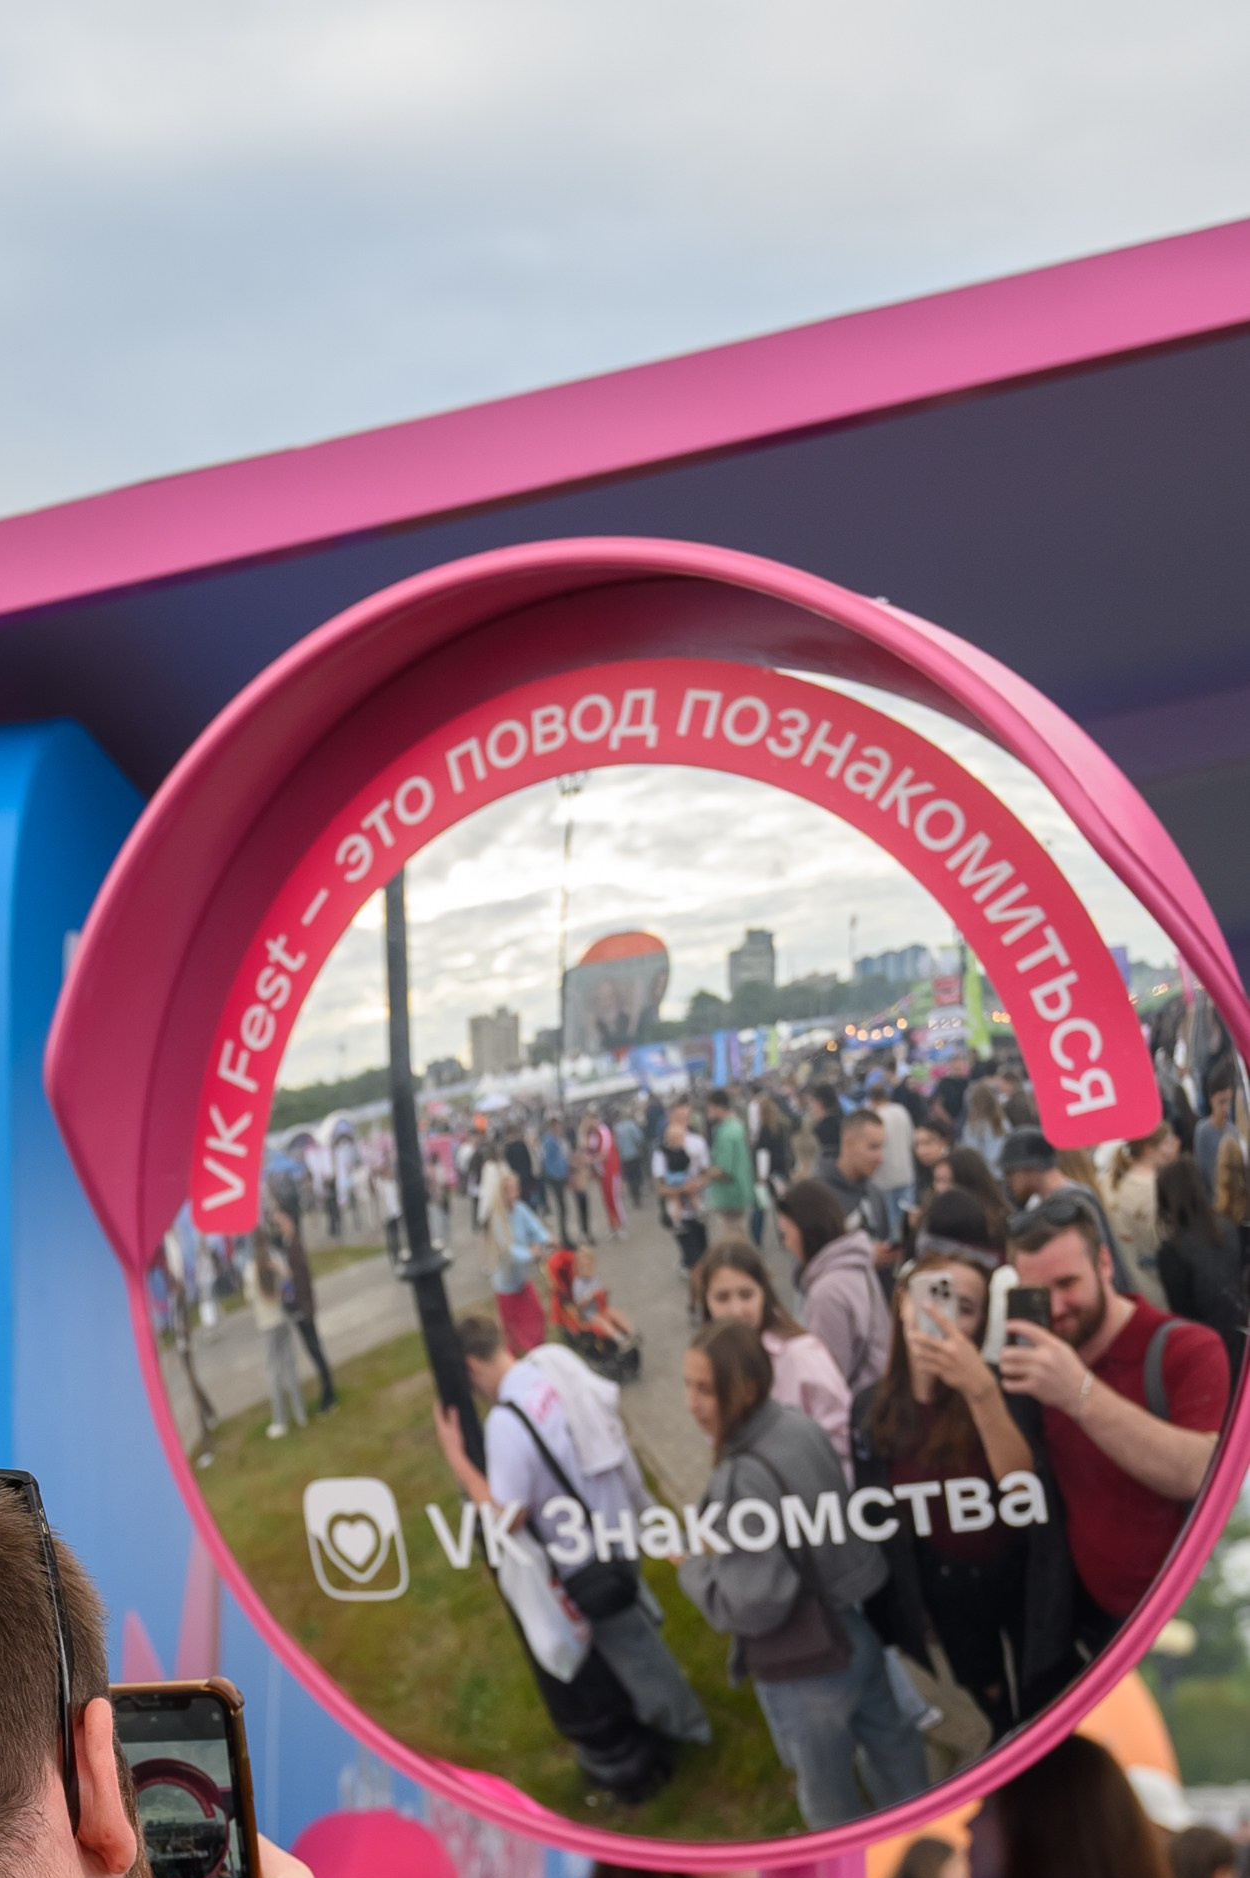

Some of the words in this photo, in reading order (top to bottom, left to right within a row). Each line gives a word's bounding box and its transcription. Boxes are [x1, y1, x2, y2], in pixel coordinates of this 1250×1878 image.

[217, 934, 307, 1094] Fest
[202, 1104, 253, 1211] VK
[426, 1501, 533, 1570] VK
[548, 1469, 1050, 1567] Знакомства
